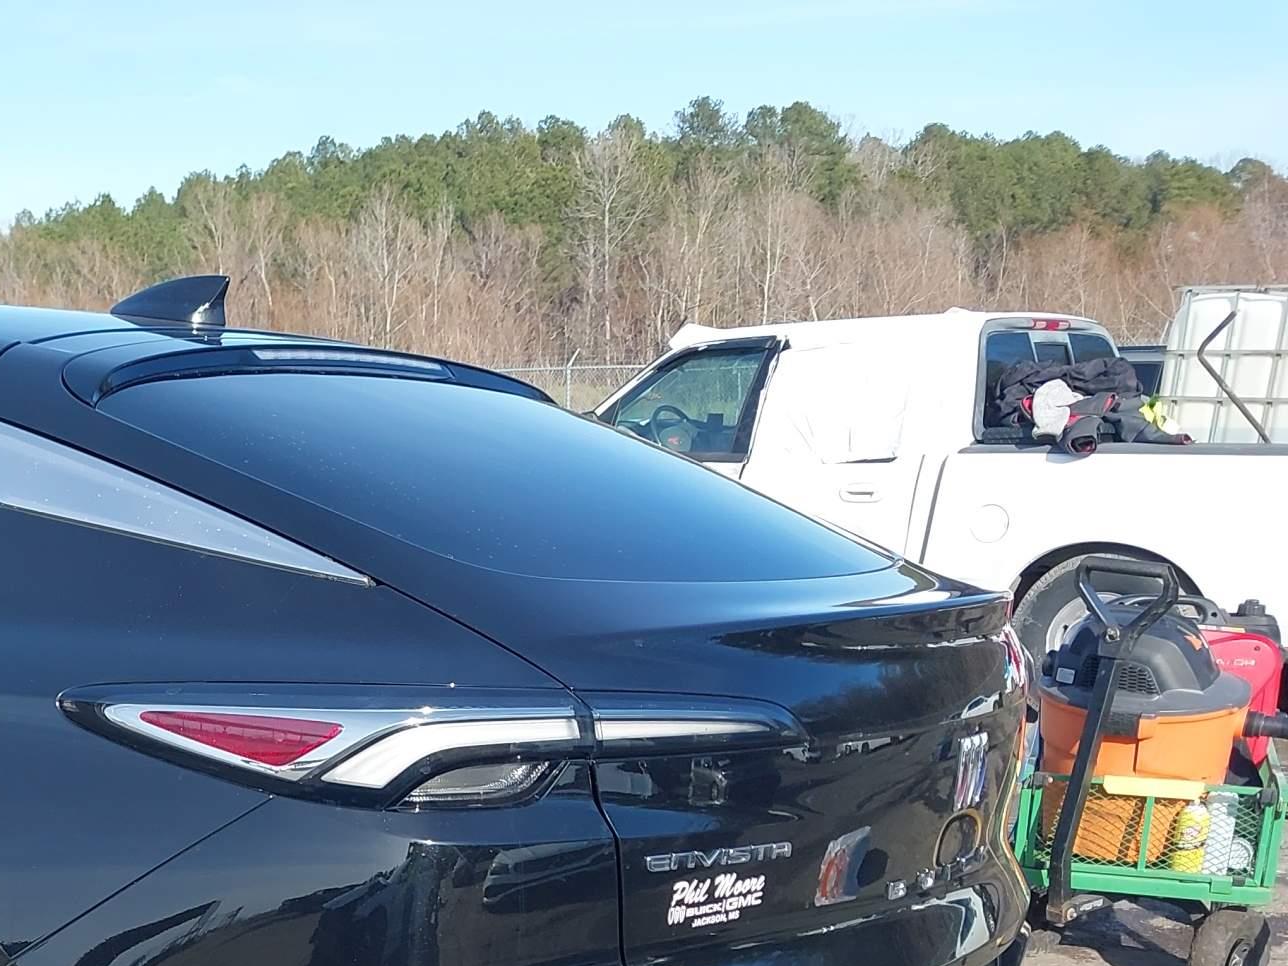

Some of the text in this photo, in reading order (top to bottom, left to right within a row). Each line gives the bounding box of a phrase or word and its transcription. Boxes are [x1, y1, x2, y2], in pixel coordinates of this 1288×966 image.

[644, 841, 793, 873] ENVISTA
[670, 872, 766, 907] Phil Moore
